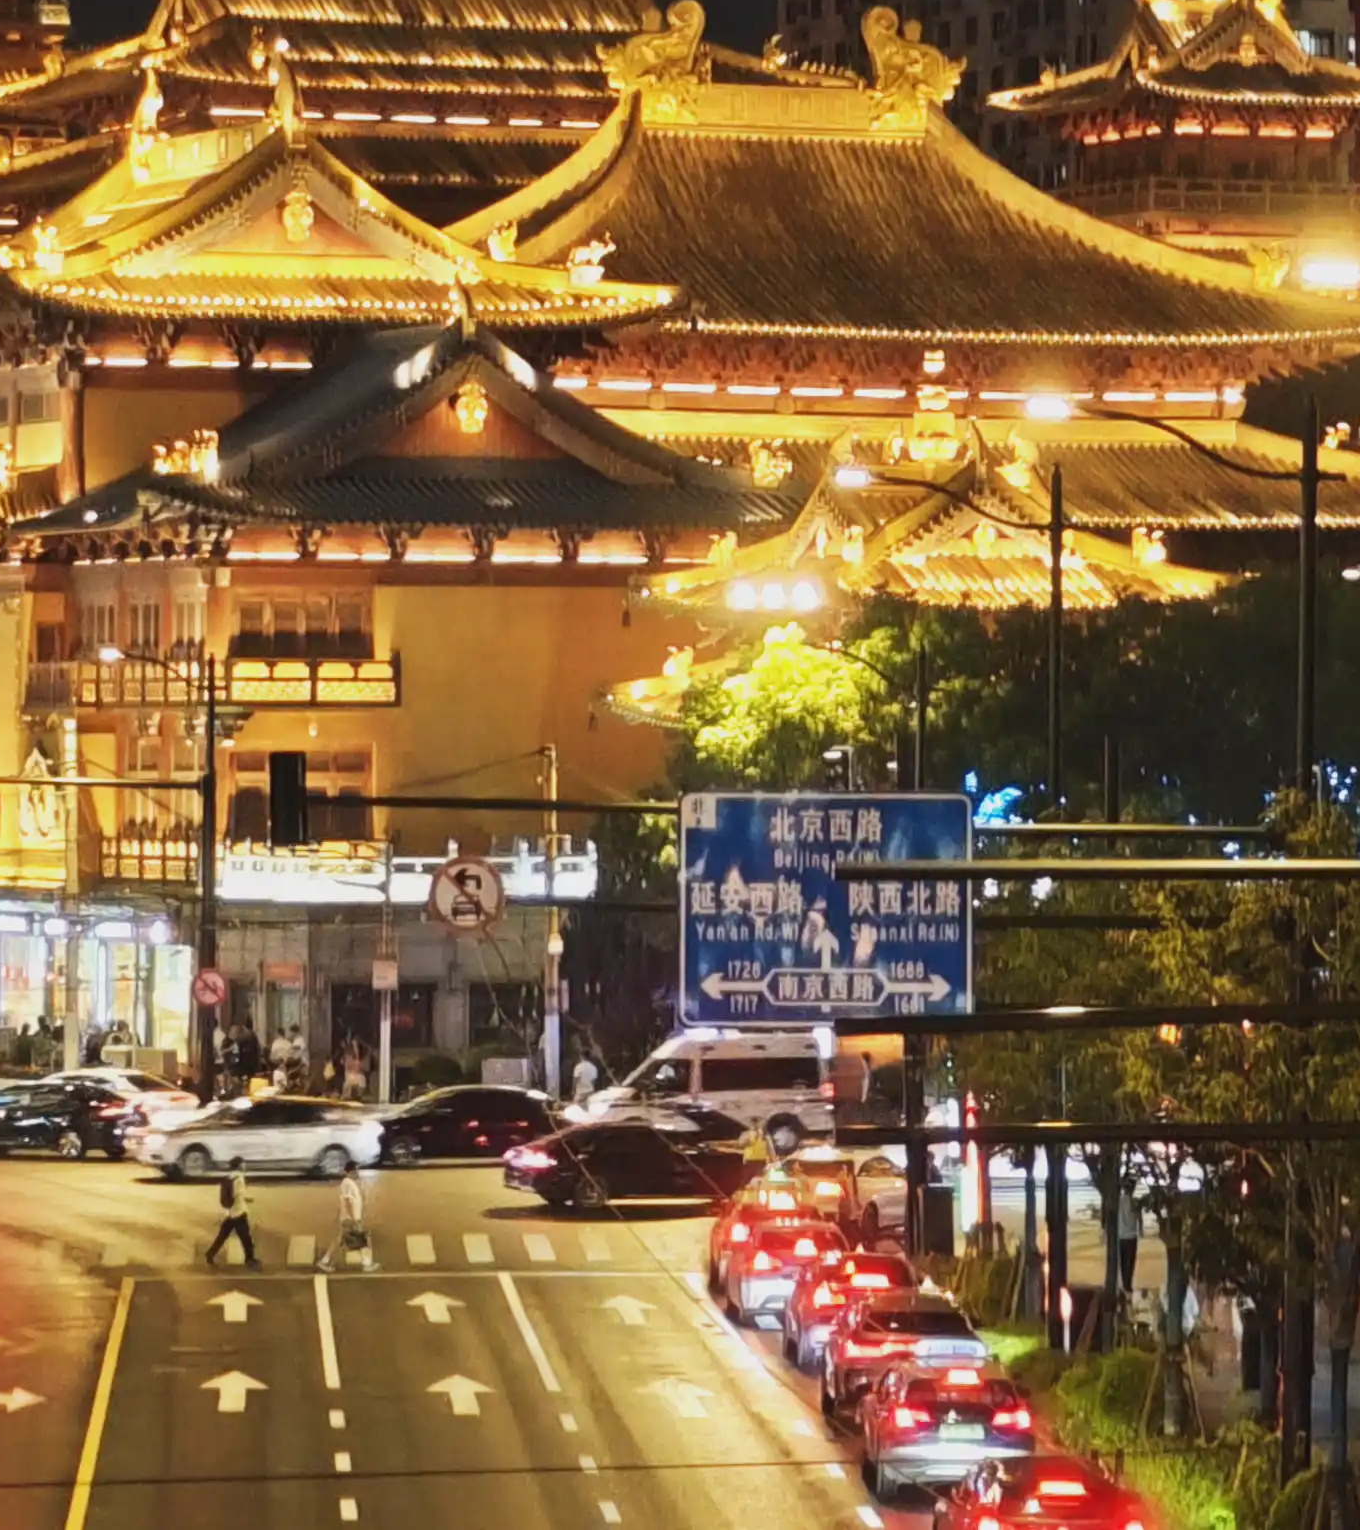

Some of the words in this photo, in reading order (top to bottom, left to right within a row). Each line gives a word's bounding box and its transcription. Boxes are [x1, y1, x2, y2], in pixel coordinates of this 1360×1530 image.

[769, 806, 883, 843] 北京西路
[773, 848, 830, 875] Beijing
[690, 879, 803, 916] 延安西路
[848, 879, 960, 917] 陕西北路
[850, 922, 914, 942] Saanxi
[778, 973, 874, 1000] 南京西路
[730, 994, 759, 1015] 1717
